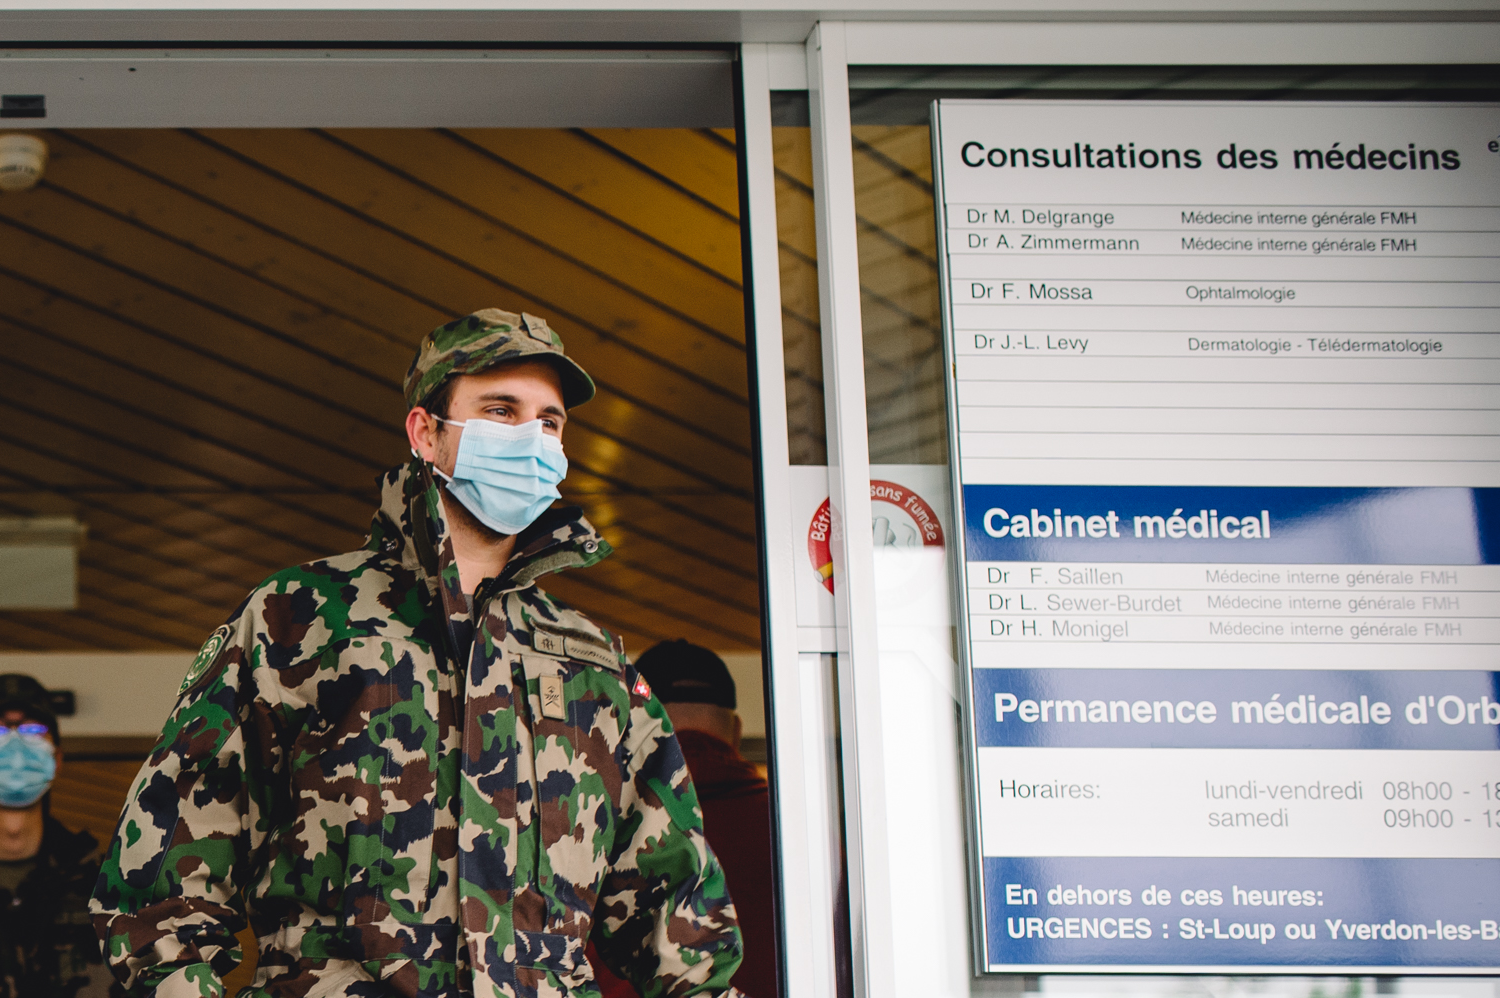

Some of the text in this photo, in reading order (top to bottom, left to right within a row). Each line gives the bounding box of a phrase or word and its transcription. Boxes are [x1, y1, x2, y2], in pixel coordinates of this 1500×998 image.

[961, 142, 1460, 170] Consultations des médecins
[968, 209, 1114, 228] Dr M. Delgrange
[1182, 212, 1416, 227] Médecine interne générale FMH
[969, 234, 1139, 250] Dr A. Zimmermann
[1182, 238, 1416, 253] Médecine interne générale FMH
[972, 283, 1092, 299] Dr F. Mossa
[1186, 286, 1295, 303] Ophtalmologie
[975, 335, 1088, 353] Dr J.-L. Levy
[1189, 338, 1291, 354] Dermatologie
[1308, 339, 1442, 355] Télédermatologie
[984, 508, 1273, 543] Cabinet médical
[988, 568, 1123, 584] Dr F. Saillen
[1206, 570, 1457, 591] Médecine interne générale FMH
[989, 594, 1182, 616] Dr L. Sewer-Burdet
[1208, 596, 1459, 617] Médecine interne générale FMH
[991, 620, 1131, 642] Dr H. Monigel
[1210, 622, 1462, 643] Médecine interne générale FMH
[995, 694, 1500, 724] Permanence médicale d'Orb
[999, 779, 1100, 800] Horaires:
[1206, 781, 1362, 800] lundi-vendredi
[1383, 782, 1452, 800] 08h00
[1209, 808, 1288, 827] samedi
[1384, 809, 1453, 828] 09h00
[1006, 884, 1323, 906] En dehors de ces heures:
[1008, 918, 1152, 939] URGENCES
[1179, 918, 1275, 944] St-Loup
[1285, 924, 1315, 939] ou
[1325, 919, 1500, 940] Yverdon-les-B
